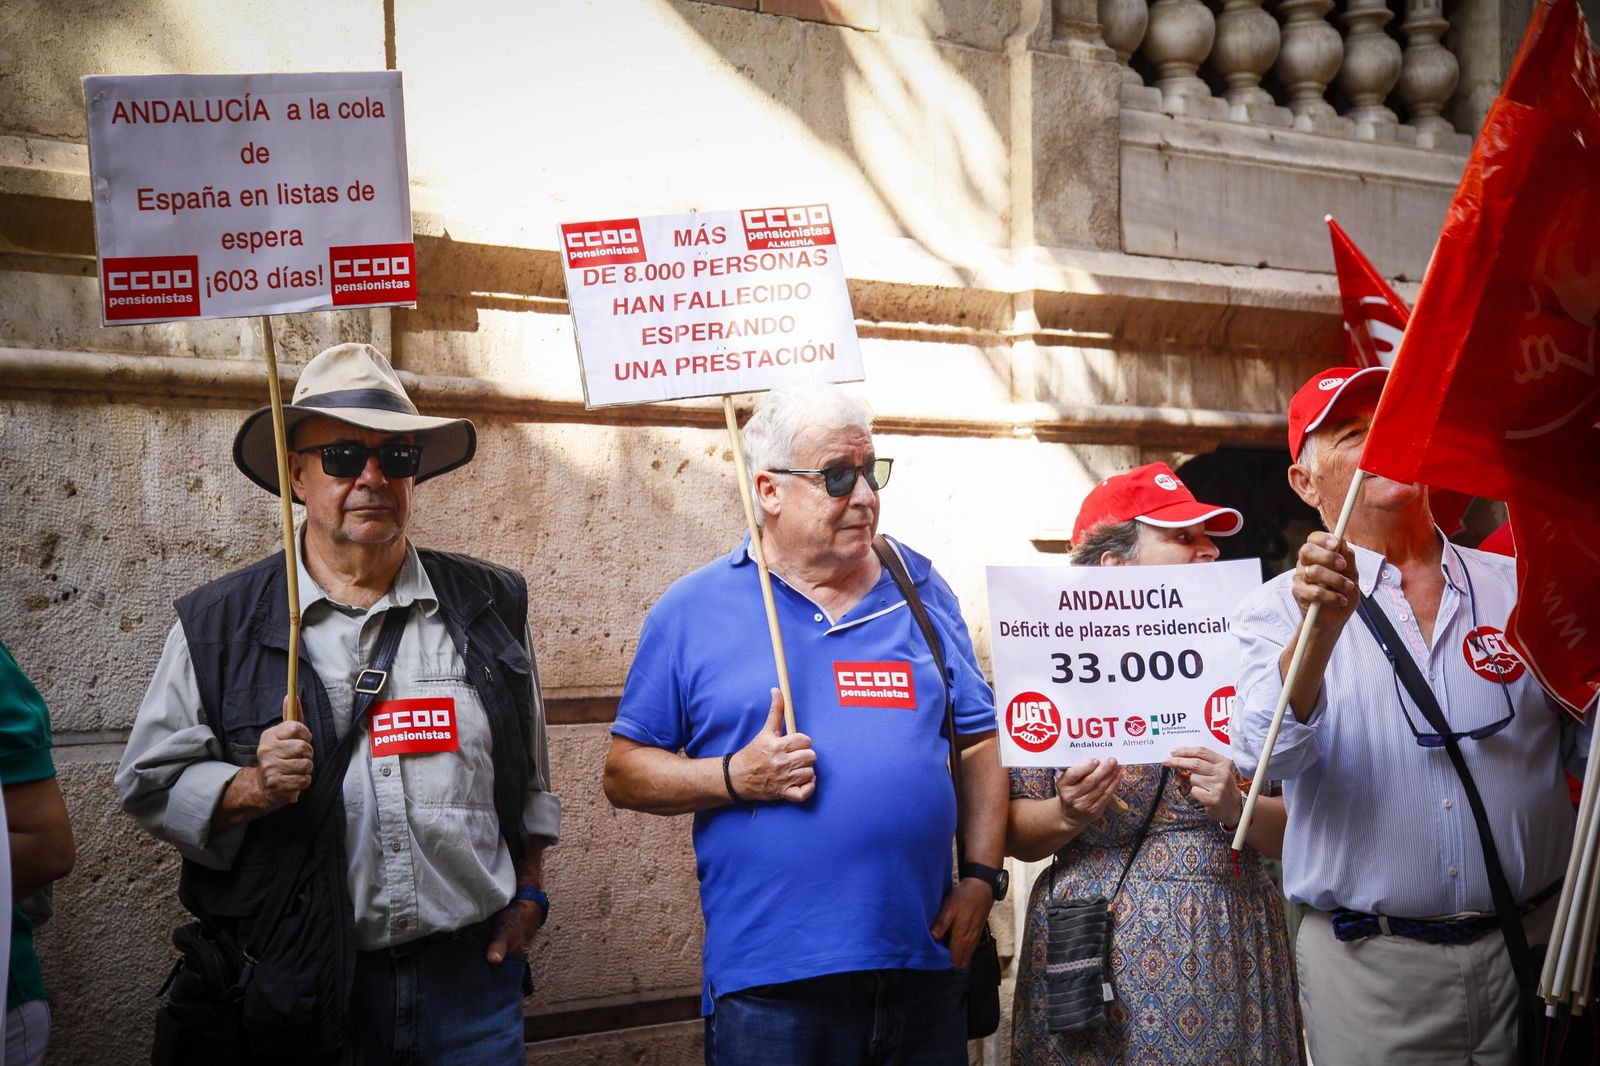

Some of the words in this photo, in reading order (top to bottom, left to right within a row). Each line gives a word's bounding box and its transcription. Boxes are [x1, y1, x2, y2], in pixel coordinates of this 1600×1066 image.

[111, 93, 270, 124] ANDALUCÍA
[287, 102, 301, 120] a
[310, 98, 330, 120] la
[338, 96, 385, 119] cola
[240, 142, 270, 165] de
[137, 185, 231, 215] España
[240, 191, 268, 207] en
[277, 183, 339, 205] listas
[347, 180, 375, 202] de
[745, 207, 831, 229] CCOO
[221, 228, 304, 254] espera
[566, 229, 638, 248] CCOO
[674, 223, 727, 248] MÁS
[748, 225, 831, 242] pensionistas
[767, 238, 815, 249] ALMERÍA
[569, 245, 639, 260] pensionistas
[333, 256, 410, 278] CCOO
[583, 266, 617, 287] DE
[624, 261, 685, 283] 8.000
[693, 249, 829, 277] PERSONAS
[108, 269, 193, 291] CCOO
[205, 271, 258, 298] ¡603
[267, 265, 324, 289] días!
[334, 279, 411, 294] pensionistas
[109, 293, 193, 308] pensionistas
[612, 294, 665, 316] HAN
[673, 282, 812, 312] FALLECIDO
[641, 315, 796, 346] ESPERANDO
[614, 358, 667, 381] UNA
[675, 340, 836, 376] PRESTACIÓN
[1058, 584, 1184, 611] ANDALUCÍA
[1000, 620, 1050, 638] Déficit
[1055, 622, 1074, 638] de
[1079, 619, 1131, 642] plazas
[1136, 617, 1231, 636] residencial
[1051, 649, 1204, 684] 33.000
[838, 671, 909, 688] CCOO
[840, 688, 910, 699] pensionistas
[372, 710, 451, 732] CCOO
[1012, 701, 1052, 724] UGT
[1160, 712, 1187, 727] UJP
[374, 730, 451, 747] pensionistas
[1066, 717, 1119, 739] UGT
[1069, 740, 1113, 749] Andalucía
[1122, 737, 1155, 747] Almería
